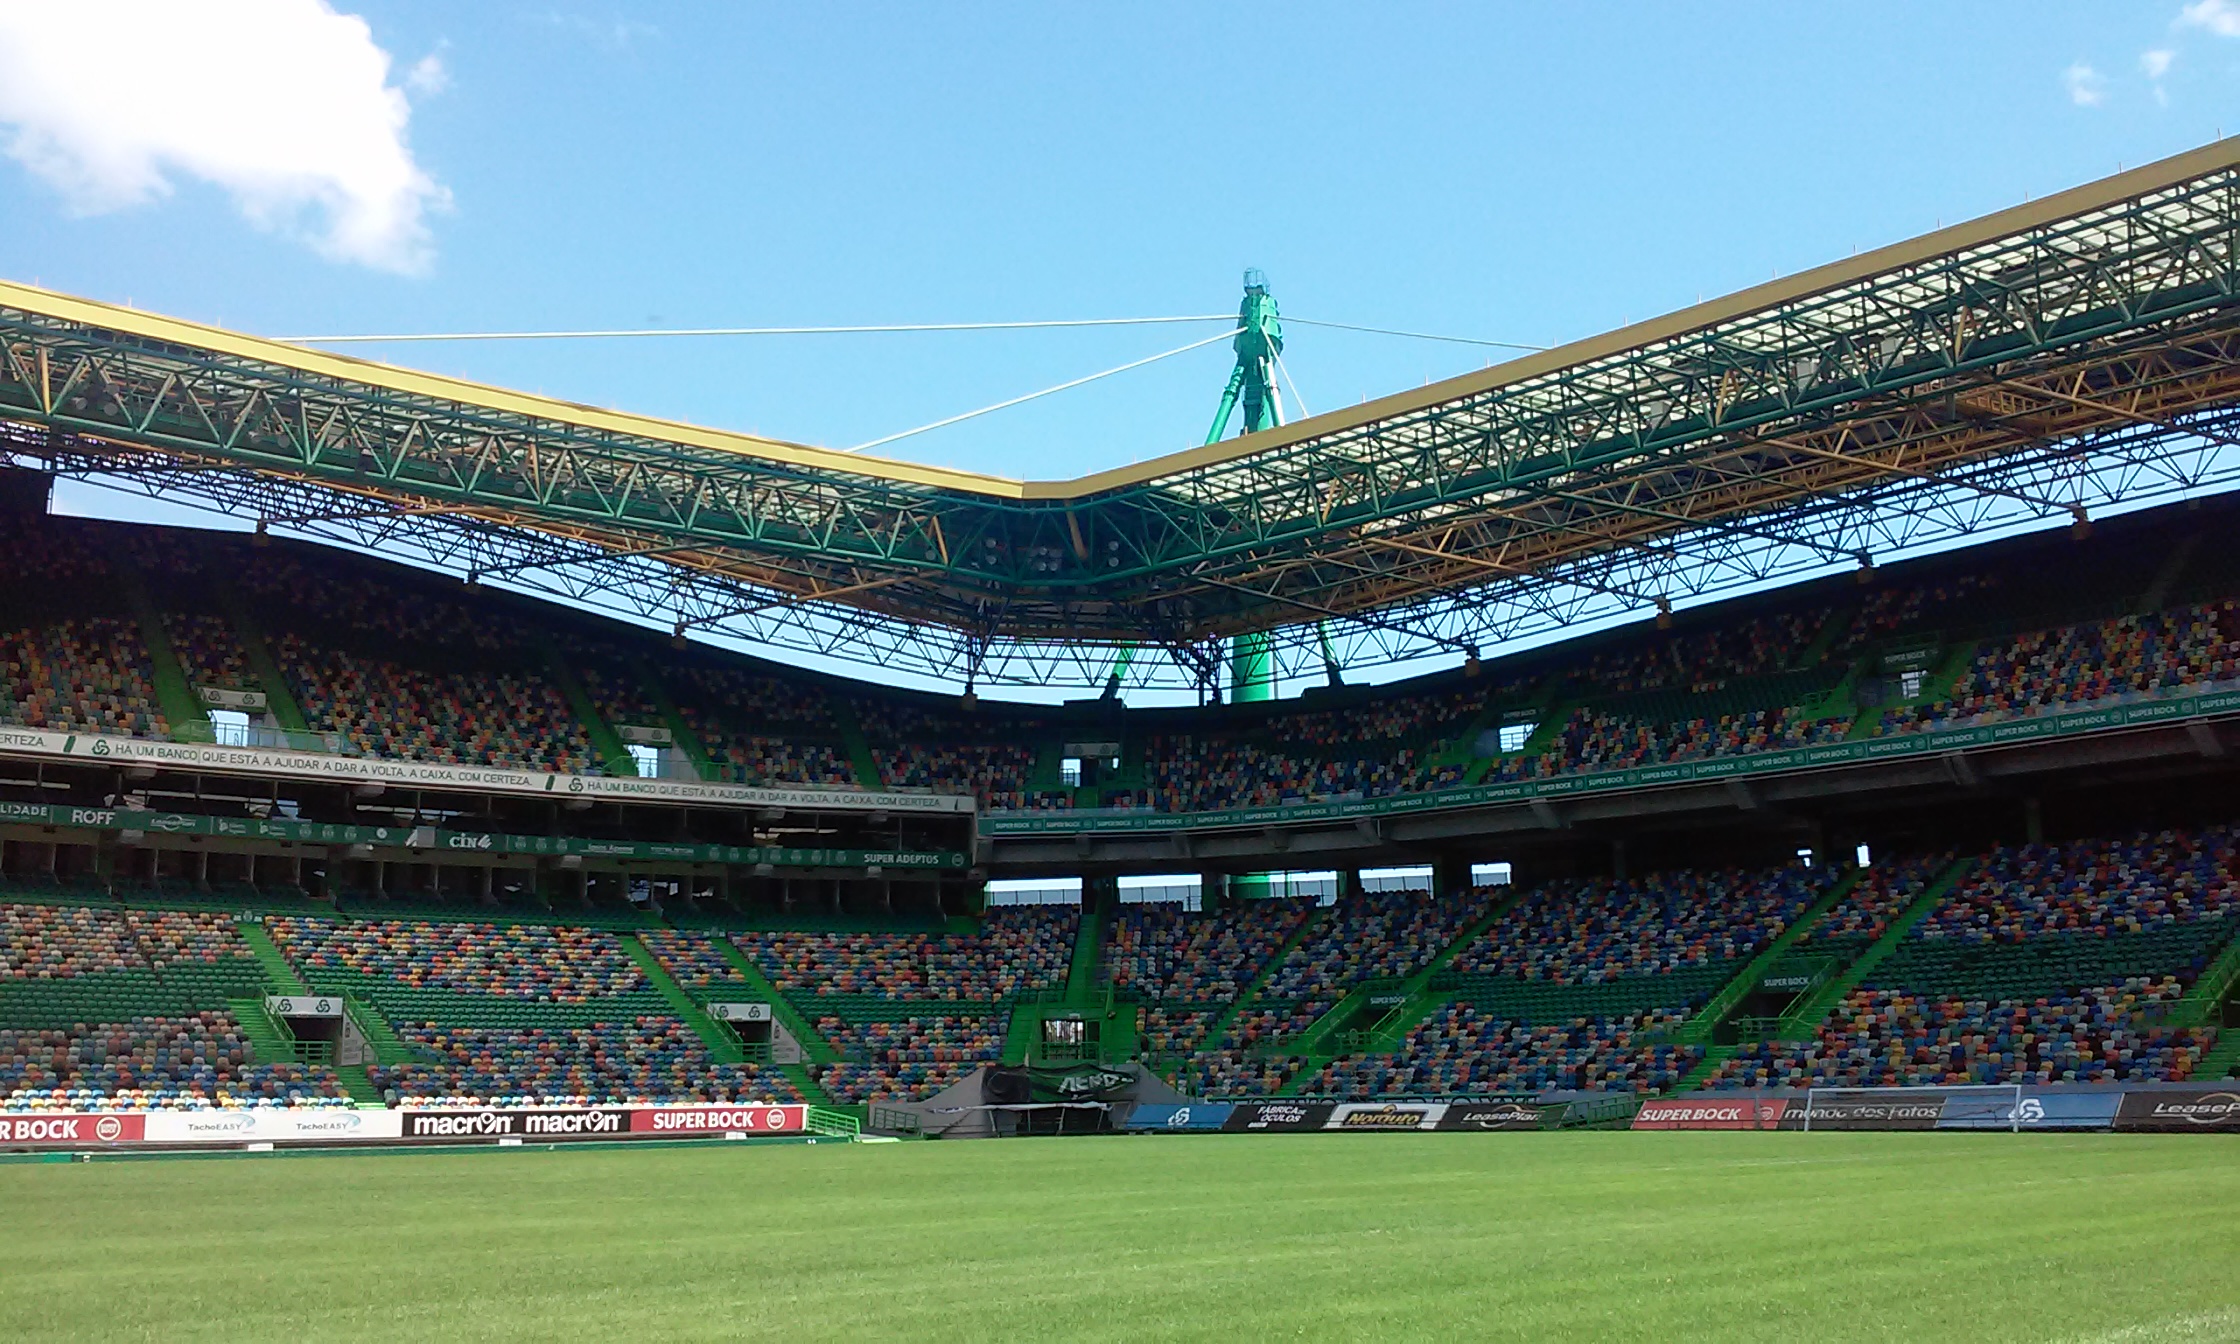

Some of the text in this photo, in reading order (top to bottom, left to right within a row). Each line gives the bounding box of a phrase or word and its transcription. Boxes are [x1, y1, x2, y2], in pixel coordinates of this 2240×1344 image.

[2200, 699, 2225, 709] SUPER
[2128, 705, 2177, 719] SUPER BOCK
[2060, 714, 2107, 728] SUPER BOCK
[1994, 725, 2038, 738] SUPER BOCK
[1931, 733, 1974, 746] SUPER BOCK
[1869, 741, 1911, 753] SUPER BOCK
[136, 746, 157, 757] UM
[158, 748, 198, 761] BANCO
[202, 751, 227, 763] QUE
[229, 752, 260, 766] ESTÁ
[263, 757, 271, 766] A
[274, 758, 320, 770] AJUDAR
[323, 761, 331, 770] A
[334, 762, 357, 774] DAR
[359, 765, 368, 774] A
[409, 769, 418, 778] A
[458, 772, 481, 782] COM
[605, 783, 621, 792] UM
[623, 783, 656, 794] BANCO
[659, 785, 680, 796] QUE
[708, 789, 716, 798] A
[718, 789, 756, 800] AJUDAR
[758, 791, 767, 800] A
[768, 791, 787, 801] DAR
[875, 797, 897, 806] COM
[71, 809, 116, 825] ROFF
[864, 853, 939, 865] SUPER ADEPTOS
[1763, 976, 1809, 987] SUPER BOCK
[1257, 1105, 1299, 1115] FÁBRICA
[1640, 1107, 1742, 1121] SUPER BOCK
[414, 1112, 511, 1134] macron
[526, 1110, 618, 1132] macron
[653, 1112, 706, 1129] SUPER
[708, 1111, 754, 1128] BOCK
[1260, 1113, 1301, 1122] ÓCULOS
[1347, 1112, 1420, 1126] Norauto
[14, 1119, 79, 1139] BOCK
[188, 1123, 242, 1131] TachoEASY
[296, 1122, 348, 1130] TachoEASY
